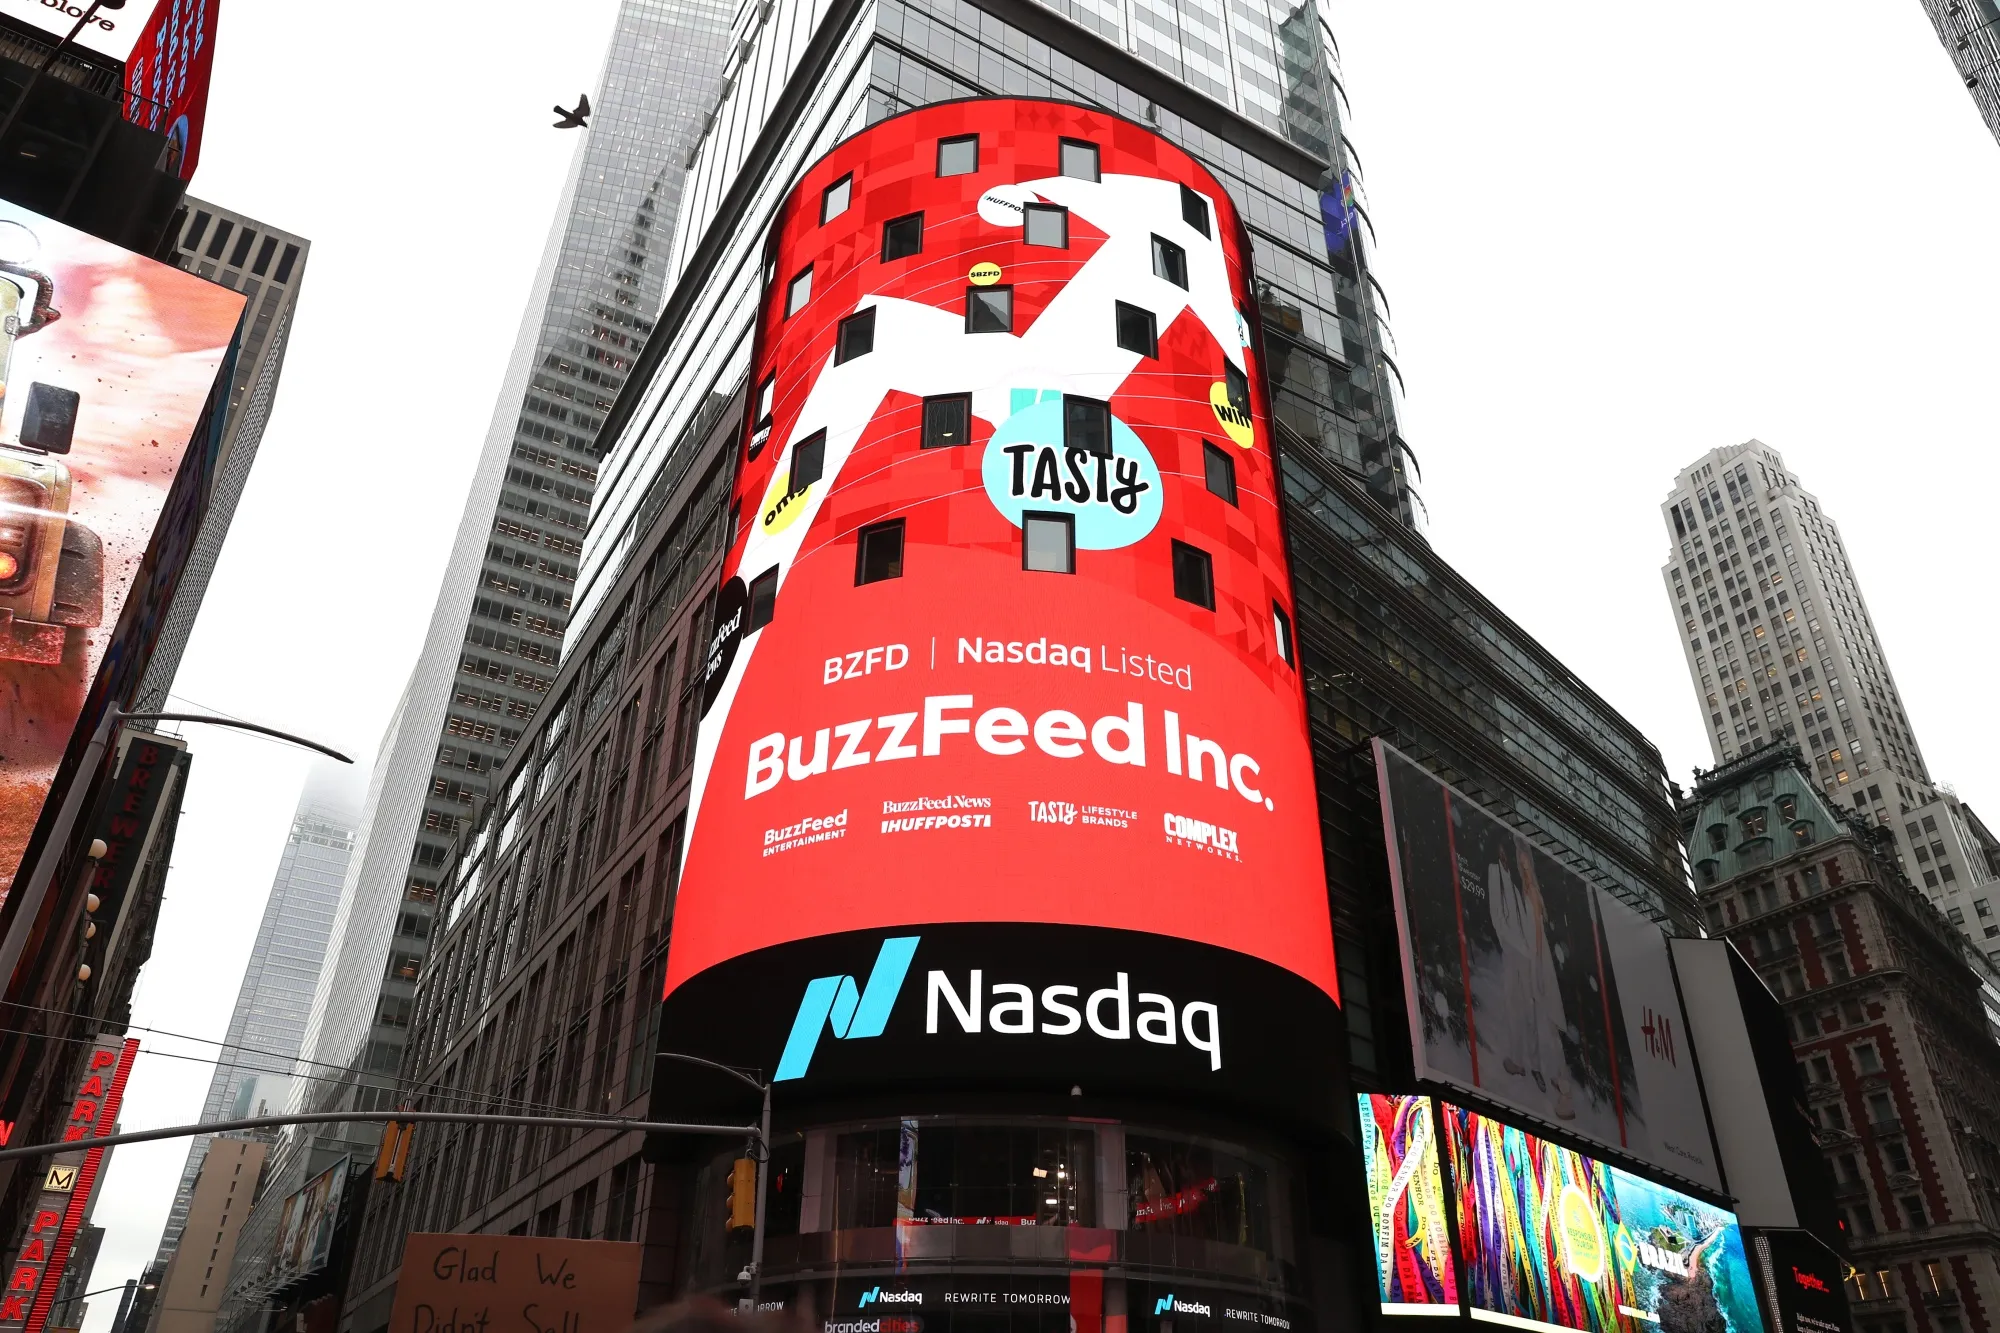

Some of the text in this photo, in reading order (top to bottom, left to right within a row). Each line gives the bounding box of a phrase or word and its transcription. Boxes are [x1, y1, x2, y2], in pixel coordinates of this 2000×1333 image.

[986, 195, 1024, 213] HUFFPOS
[823, 637, 1192, 691] BZFD Nasdaq Listed
[744, 694, 1275, 812] BuzzFeed Inc.
[764, 809, 848, 846] BuzzFeed
[1081, 805, 1138, 820] LIFESTYLE
[1081, 815, 1128, 828] BRANDS
[762, 828, 847, 857] ENTERTAINMENT
[1163, 812, 1240, 854] COMPLEX
[926, 969, 1221, 1071] Nasdaq
[1641, 1005, 1676, 1069] H&M
[64, 1050, 114, 1142] PARK
[1382, 1212, 1390, 1248] BONFIM
[0, 1210, 59, 1321] PARK
[433, 1246, 577, 1290] Glad We
[1639, 1241, 1689, 1277] BRAZIL
[879, 1290, 1071, 1305] Nasdaq REWRITE TOMORROW
[1173, 1300, 1211, 1317] Nasdaq
[1226, 1308, 1258, 1323] REWRITE
